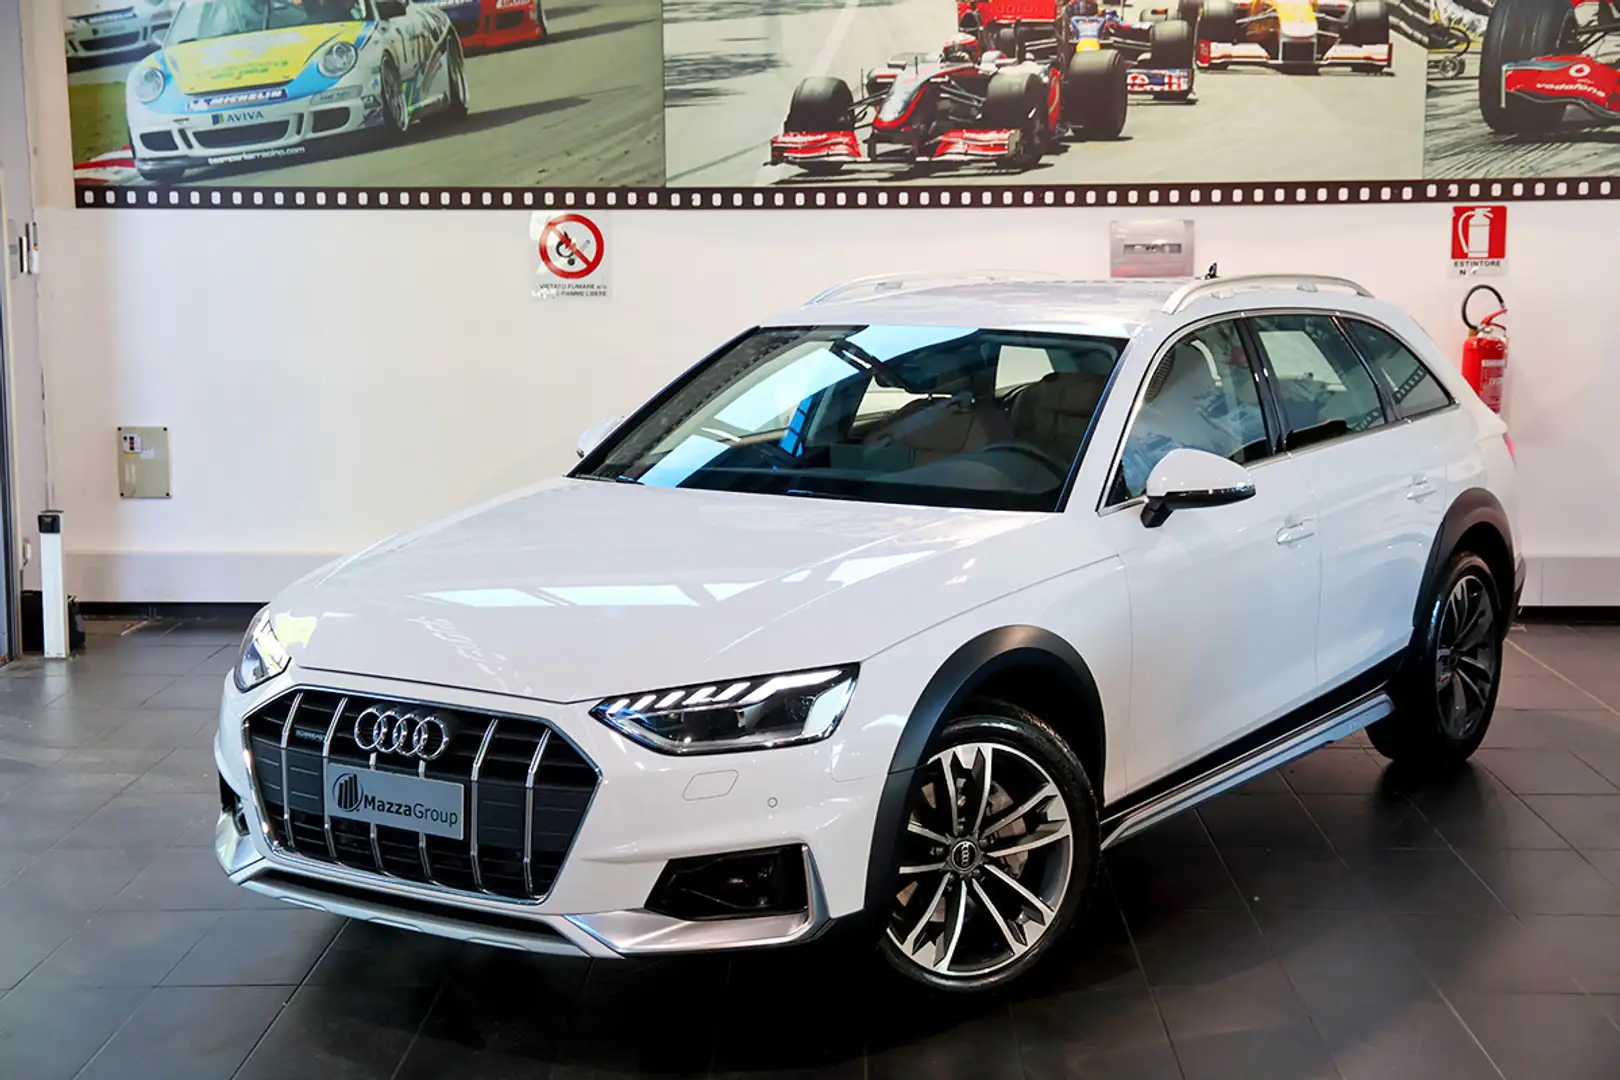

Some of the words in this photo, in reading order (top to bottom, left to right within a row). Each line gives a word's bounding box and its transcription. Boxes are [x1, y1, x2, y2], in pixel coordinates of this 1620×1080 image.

[1536, 83, 1606, 97] vodafone
[210, 90, 282, 105] MICHELIN
[227, 110, 264, 123] AVIVA
[364, 794, 458, 827] MazzaGroup
